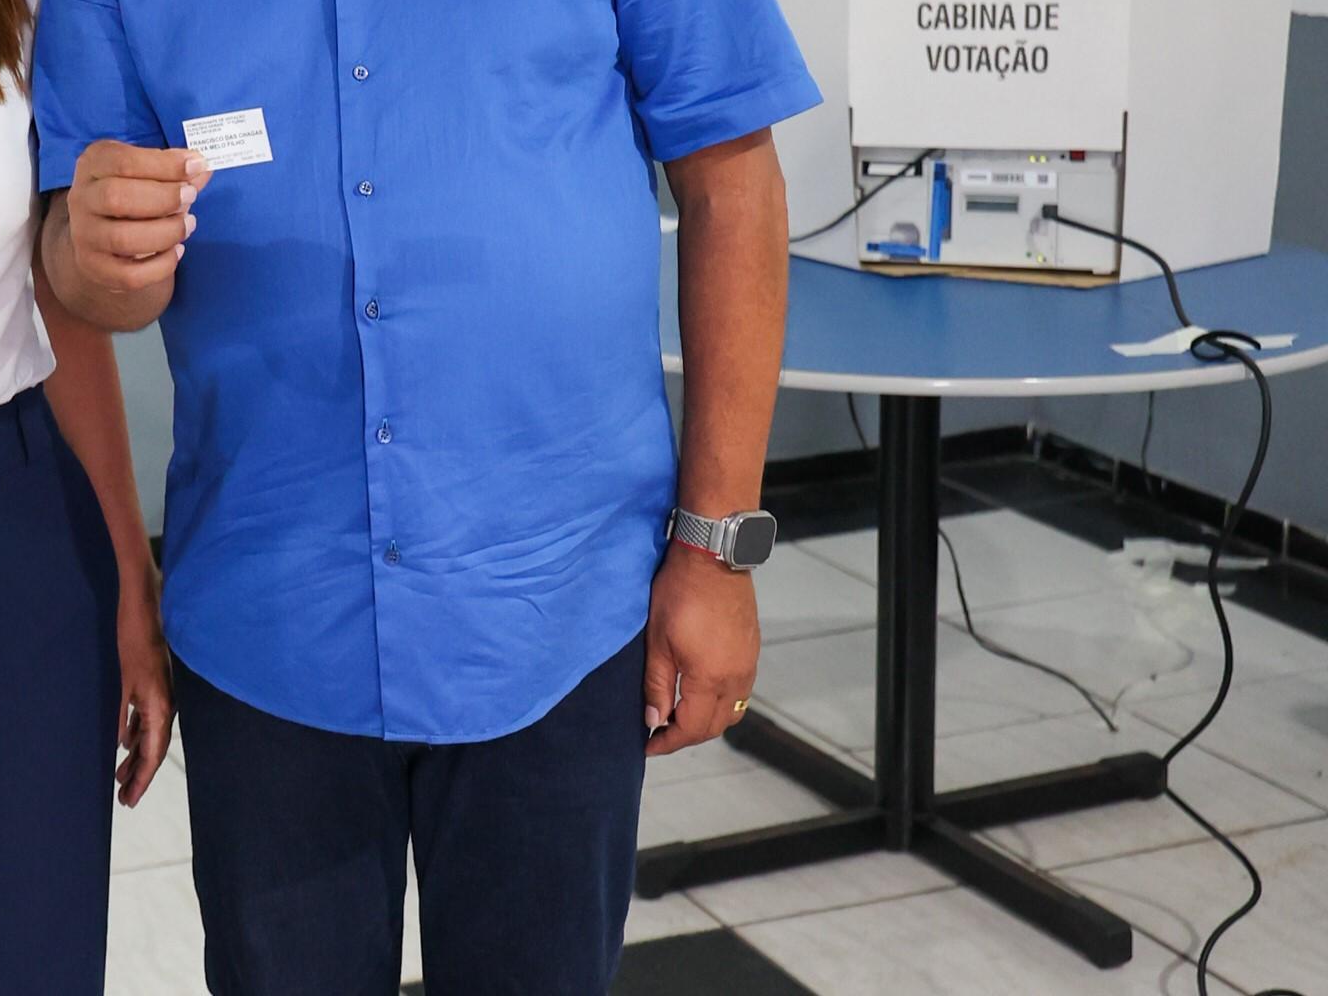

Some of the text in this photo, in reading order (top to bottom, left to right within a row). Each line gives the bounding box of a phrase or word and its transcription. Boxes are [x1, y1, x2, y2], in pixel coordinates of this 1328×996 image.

[917, 3, 1060, 31] CABINA DE
[926, 39, 1049, 81] VOTAÇÃO
